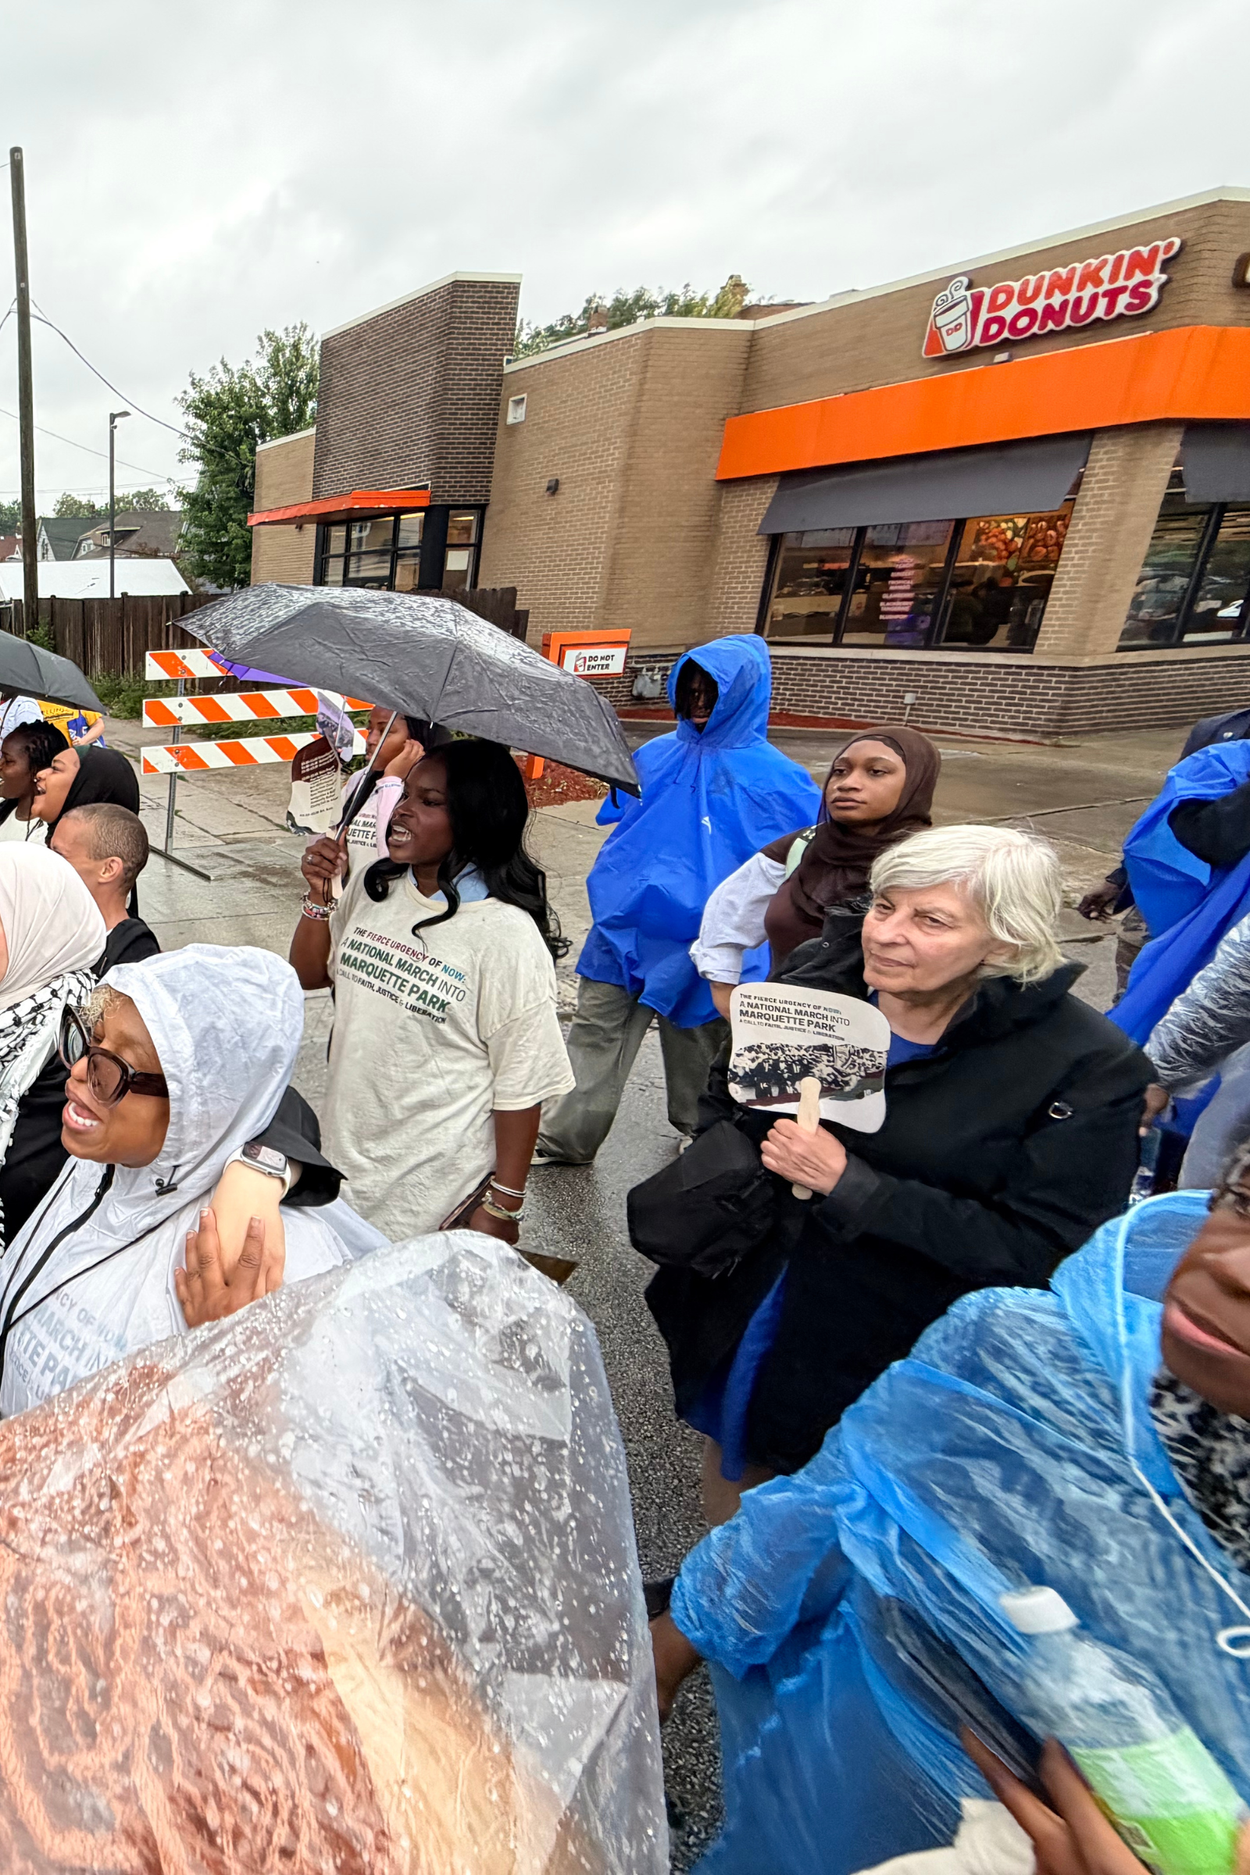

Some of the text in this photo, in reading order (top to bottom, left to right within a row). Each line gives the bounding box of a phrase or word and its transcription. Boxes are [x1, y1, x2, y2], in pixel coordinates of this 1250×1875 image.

[986, 240, 1175, 314] DUNKIN'
[979, 279, 1154, 344] DONUTS
[586, 663, 610, 672] ENTER
[600, 654, 616, 662] NOT
[341, 936, 467, 1002] A NATIONAL MARCH INTO
[354, 926, 467, 984] THE FIERCE URGENCY OF NOW:
[340, 952, 452, 1013] MARQUETTE PARK
[357, 978, 376, 993] FAITH,
[376, 986, 400, 1004] JUSTICE
[404, 1001, 447, 1025] LIBERATION
[753, 995, 778, 1004] FIERCE
[778, 999, 812, 1009] URGENCY
[739, 1000, 851, 1027] A NATIONAL MARCH INTO
[739, 1009, 837, 1033] MARQUETTE PARK
[33, 1305, 89, 1363] MARCH
[76, 1308, 97, 1326] OF
